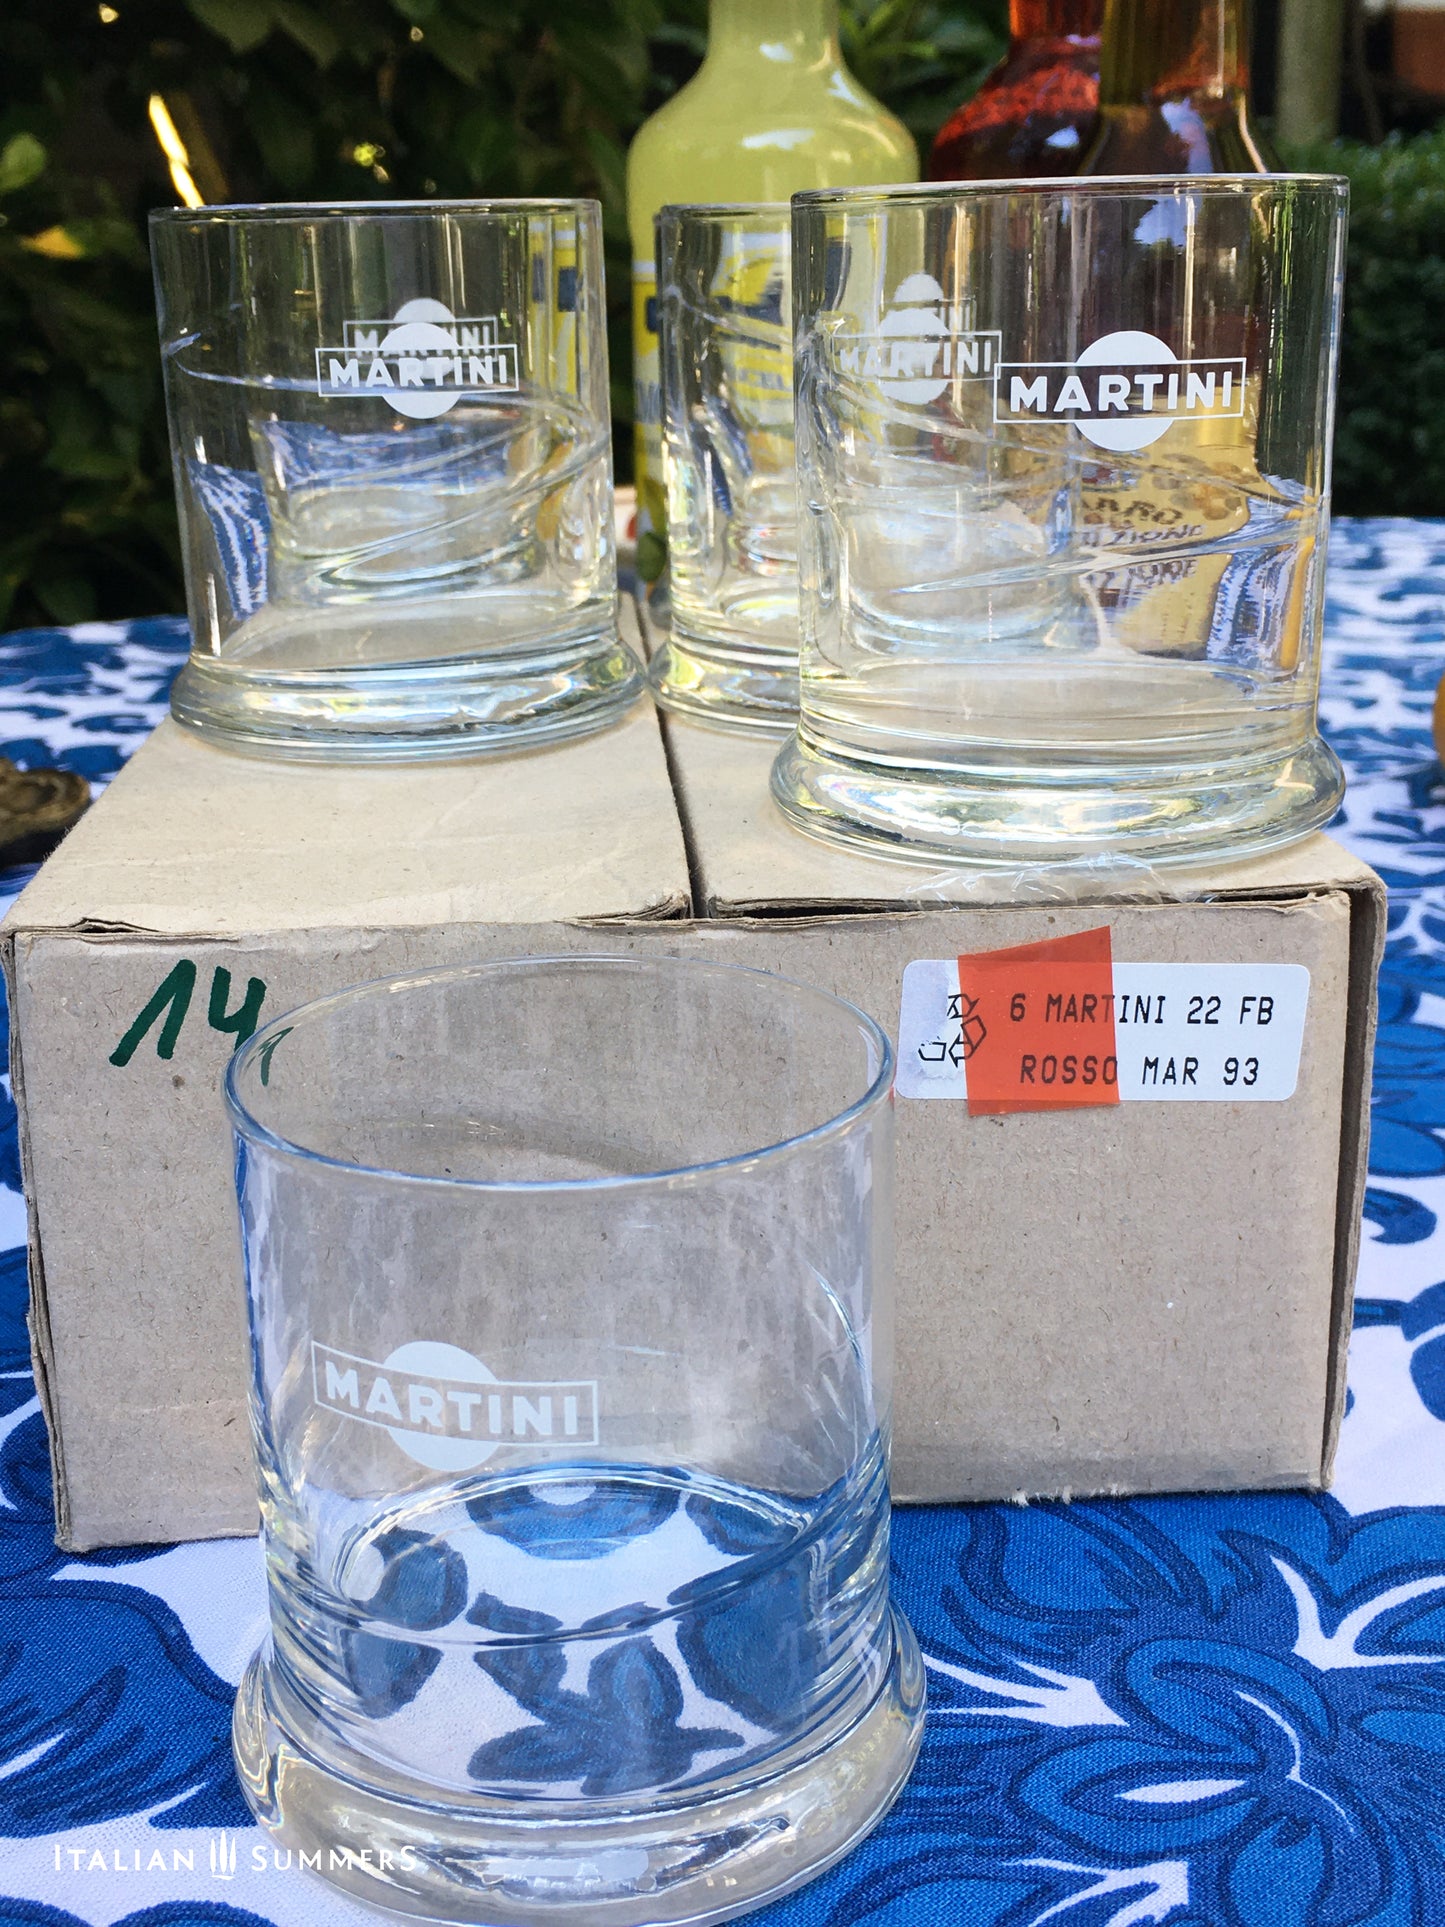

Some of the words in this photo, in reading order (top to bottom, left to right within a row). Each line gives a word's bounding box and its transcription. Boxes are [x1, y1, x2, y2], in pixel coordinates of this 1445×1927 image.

[354, 325, 490, 358] MINI
[329, 354, 507, 388] MARTINI
[1010, 370, 1233, 413] MARTINI
[109, 959, 272, 1082] 14
[1009, 992, 1026, 1023] 6
[1045, 993, 1165, 1024] MARTINI
[1187, 995, 1222, 1025] 22
[1239, 996, 1274, 1026] FB
[1020, 1054, 1118, 1085] ROSSO
[1142, 1056, 1199, 1085] MAR
[1223, 1057, 1259, 1086] 93
[325, 1359, 577, 1436] MARTINI
